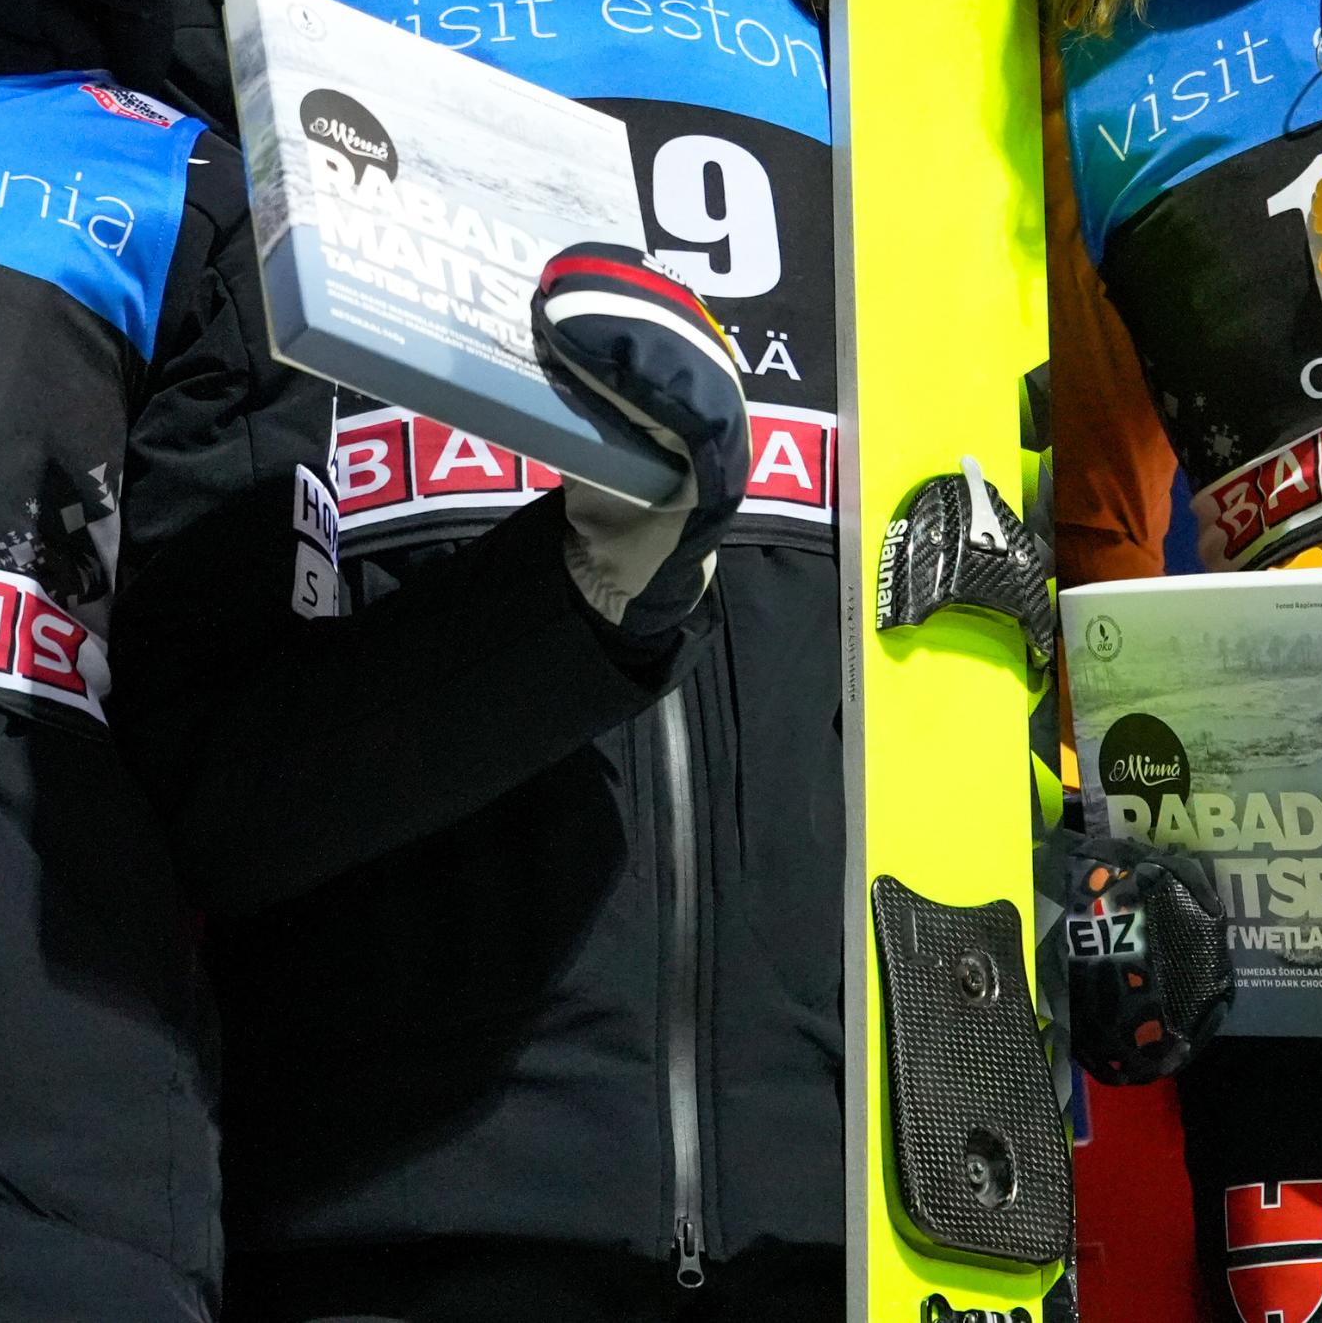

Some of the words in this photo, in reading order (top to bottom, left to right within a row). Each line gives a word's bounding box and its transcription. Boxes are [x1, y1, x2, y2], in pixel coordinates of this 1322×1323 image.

[1097, 30, 1274, 162] visit
[877, 518, 909, 620] Slatnar
[1235, 967, 1277, 977] TUMEDAS
[1250, 979, 1273, 988] WITH
[1274, 979, 1299, 988] DARK
